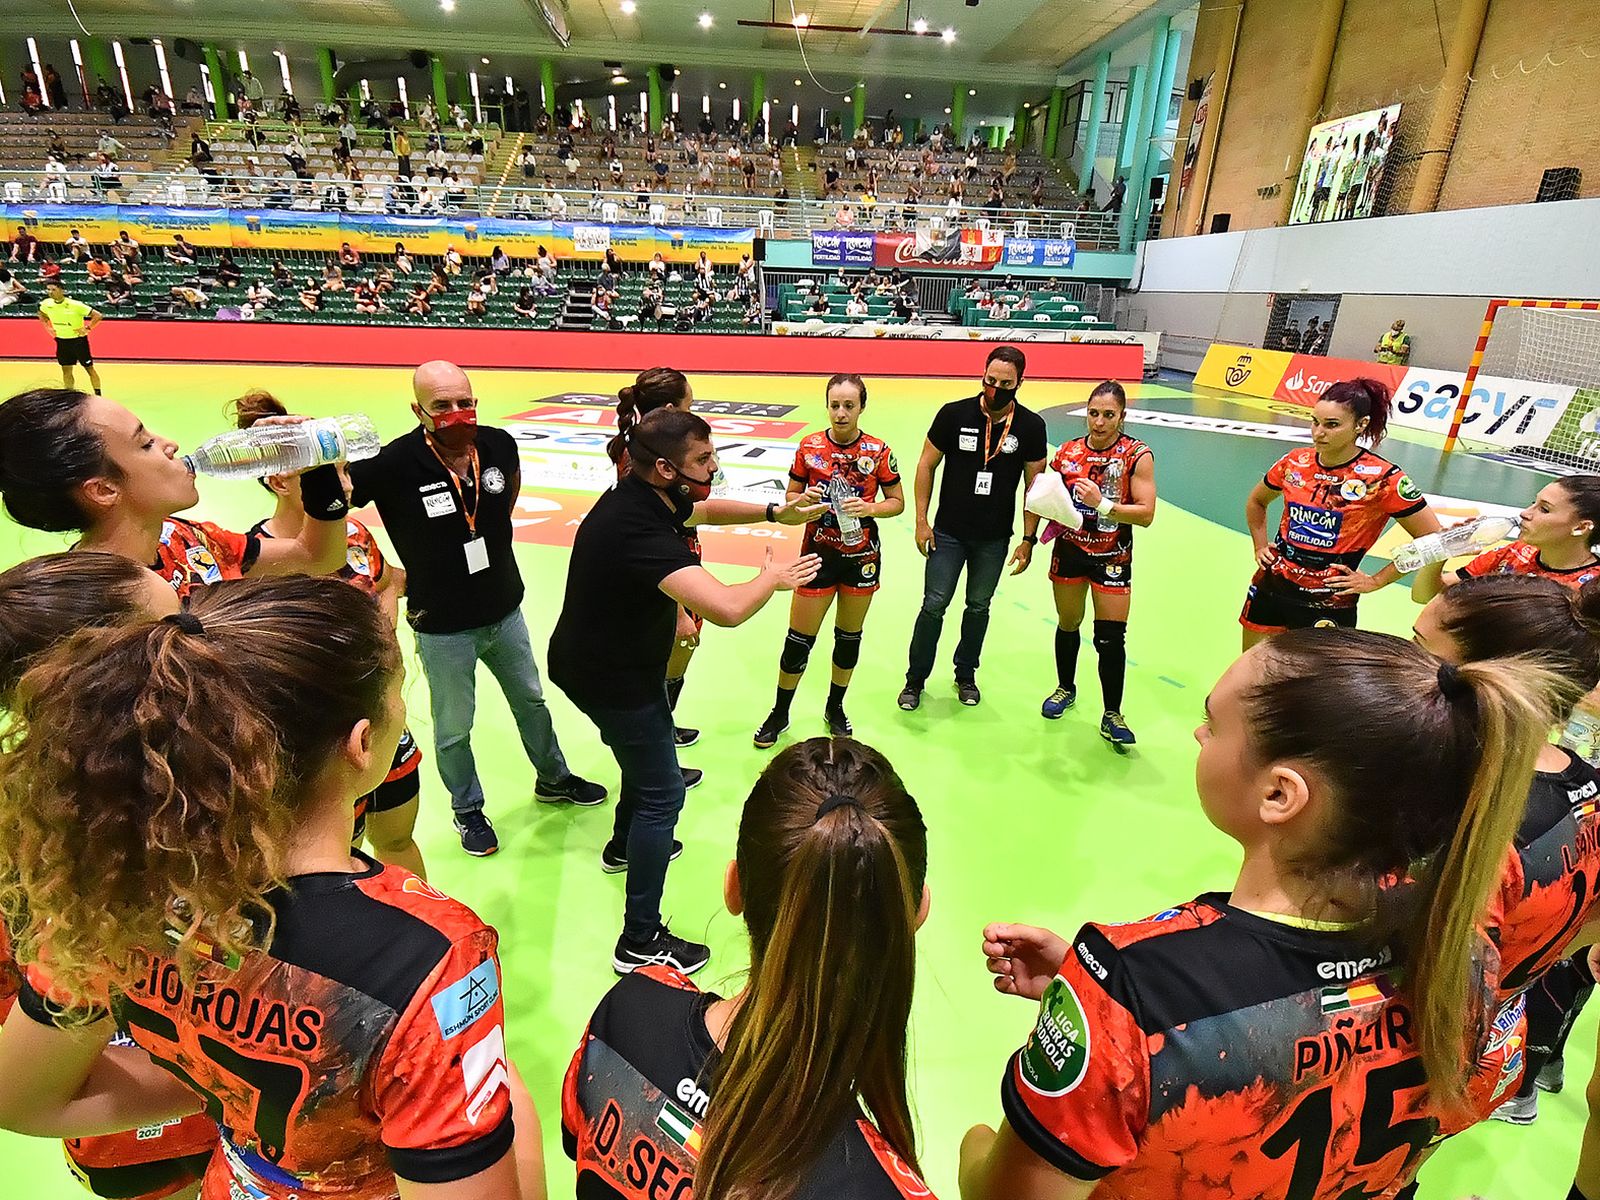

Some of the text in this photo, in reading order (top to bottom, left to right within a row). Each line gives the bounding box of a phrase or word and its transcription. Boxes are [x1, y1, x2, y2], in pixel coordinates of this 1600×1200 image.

[731, 527, 788, 540] SOL
[1288, 530, 1334, 548] FERTILIDAD
[190, 973, 320, 1051] ROJAS
[1055, 1010, 1079, 1043] LIGA
[138, 1128, 162, 1139] 2021
[1260, 1056, 1441, 1200] 15
